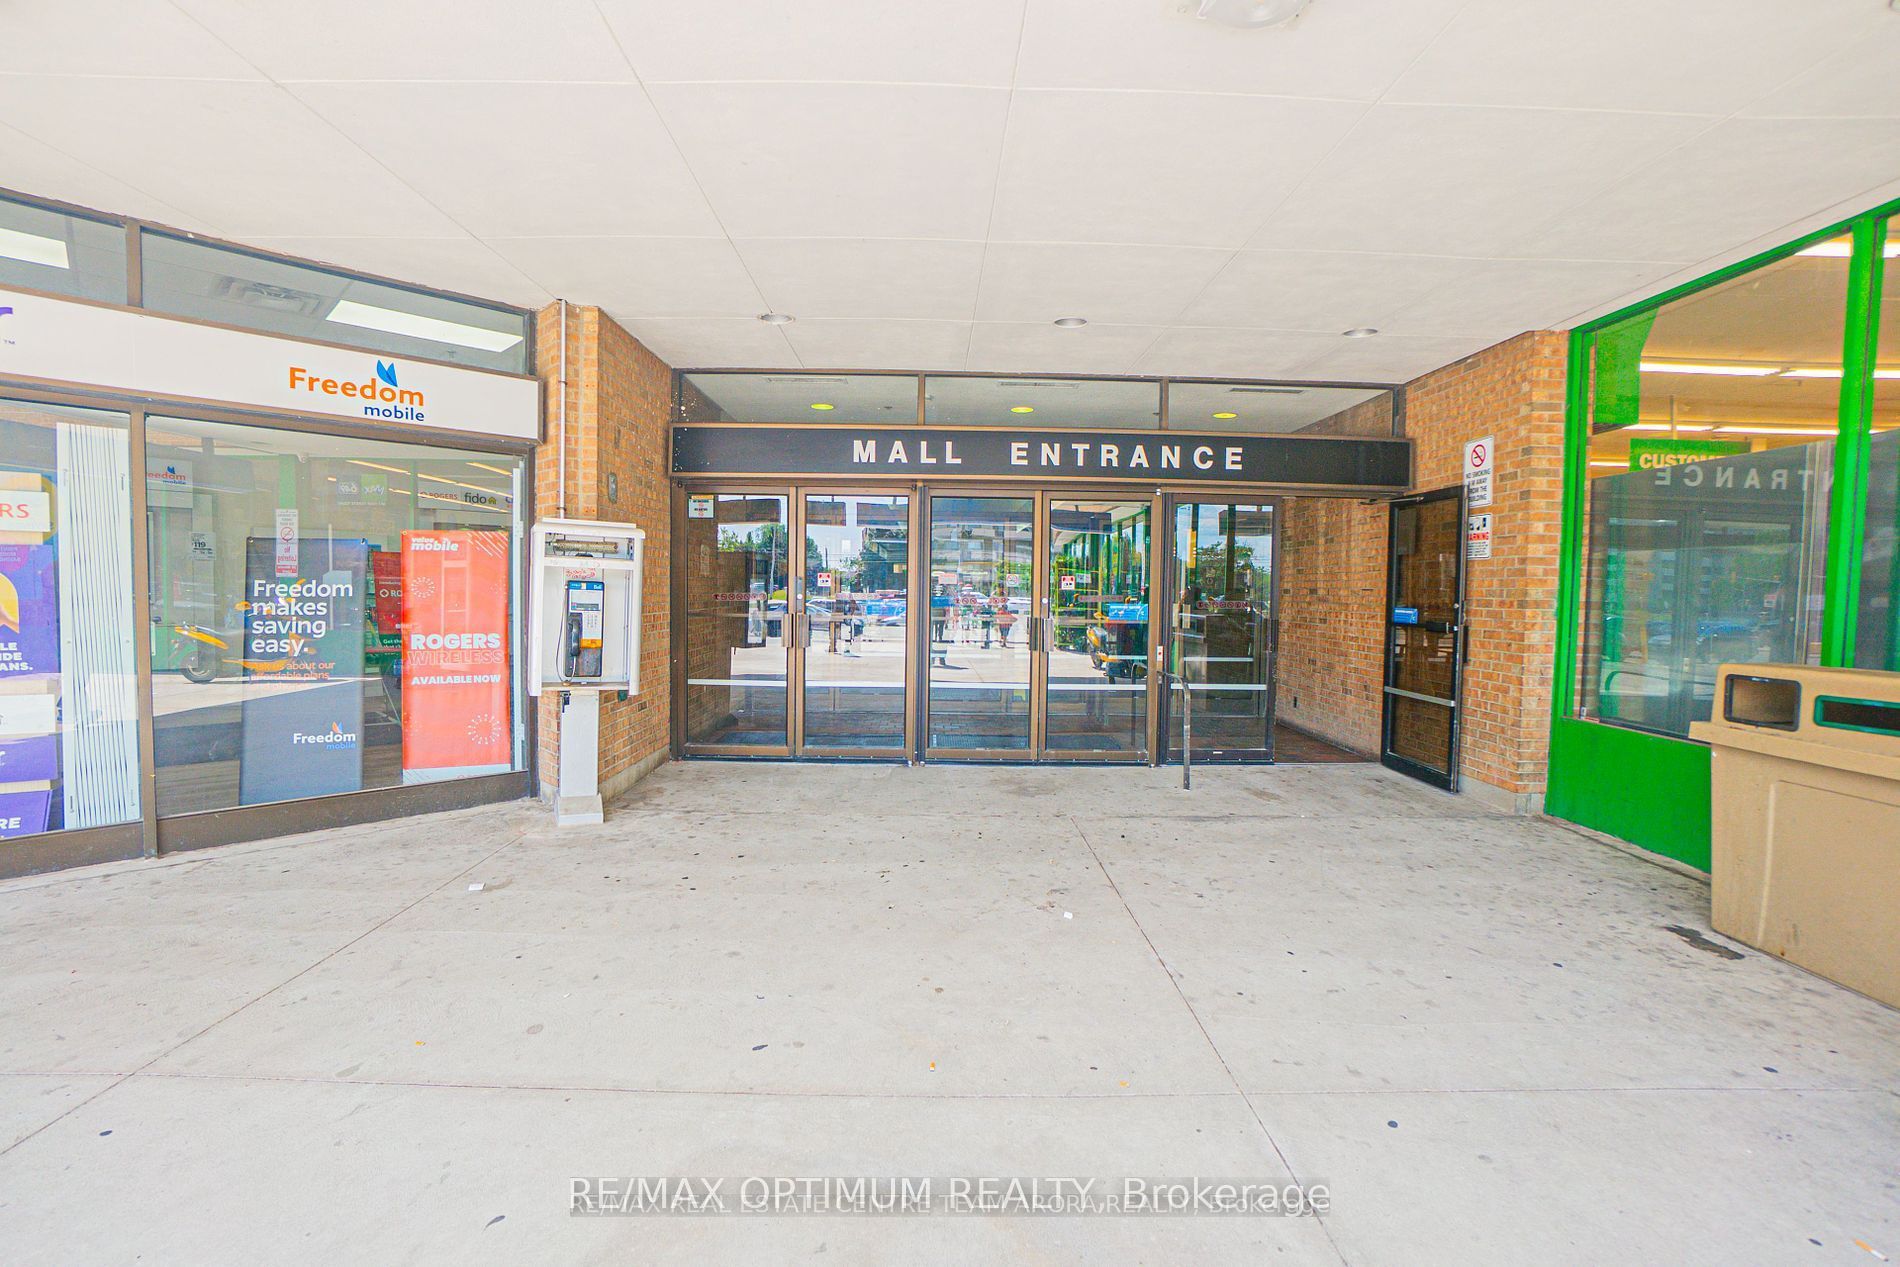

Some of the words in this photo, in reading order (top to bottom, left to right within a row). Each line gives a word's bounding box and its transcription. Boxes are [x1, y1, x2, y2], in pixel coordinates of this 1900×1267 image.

[289, 366, 424, 406] Freedom
[364, 405, 425, 421] mobile
[853, 440, 962, 464] MALL
[1010, 442, 1243, 470] ENTRANCE
[1639, 453, 1727, 469] CUSTO
[145, 472, 186, 480] eedom
[464, 492, 486, 504] fido
[411, 538, 458, 551] mobile
[253, 579, 353, 597] Freedom
[251, 600, 327, 616] makes
[252, 617, 326, 638] saving
[251, 638, 309, 657] easy.
[411, 634, 500, 650] ROGERS
[286, 660, 316, 670] about
[319, 662, 335, 670] our
[408, 650, 505, 666] WIRELESS
[304, 671, 329, 680] plans
[411, 676, 473, 685] AVAILABLE
[474, 675, 502, 684] NOW
[293, 731, 356, 744] Freedom
